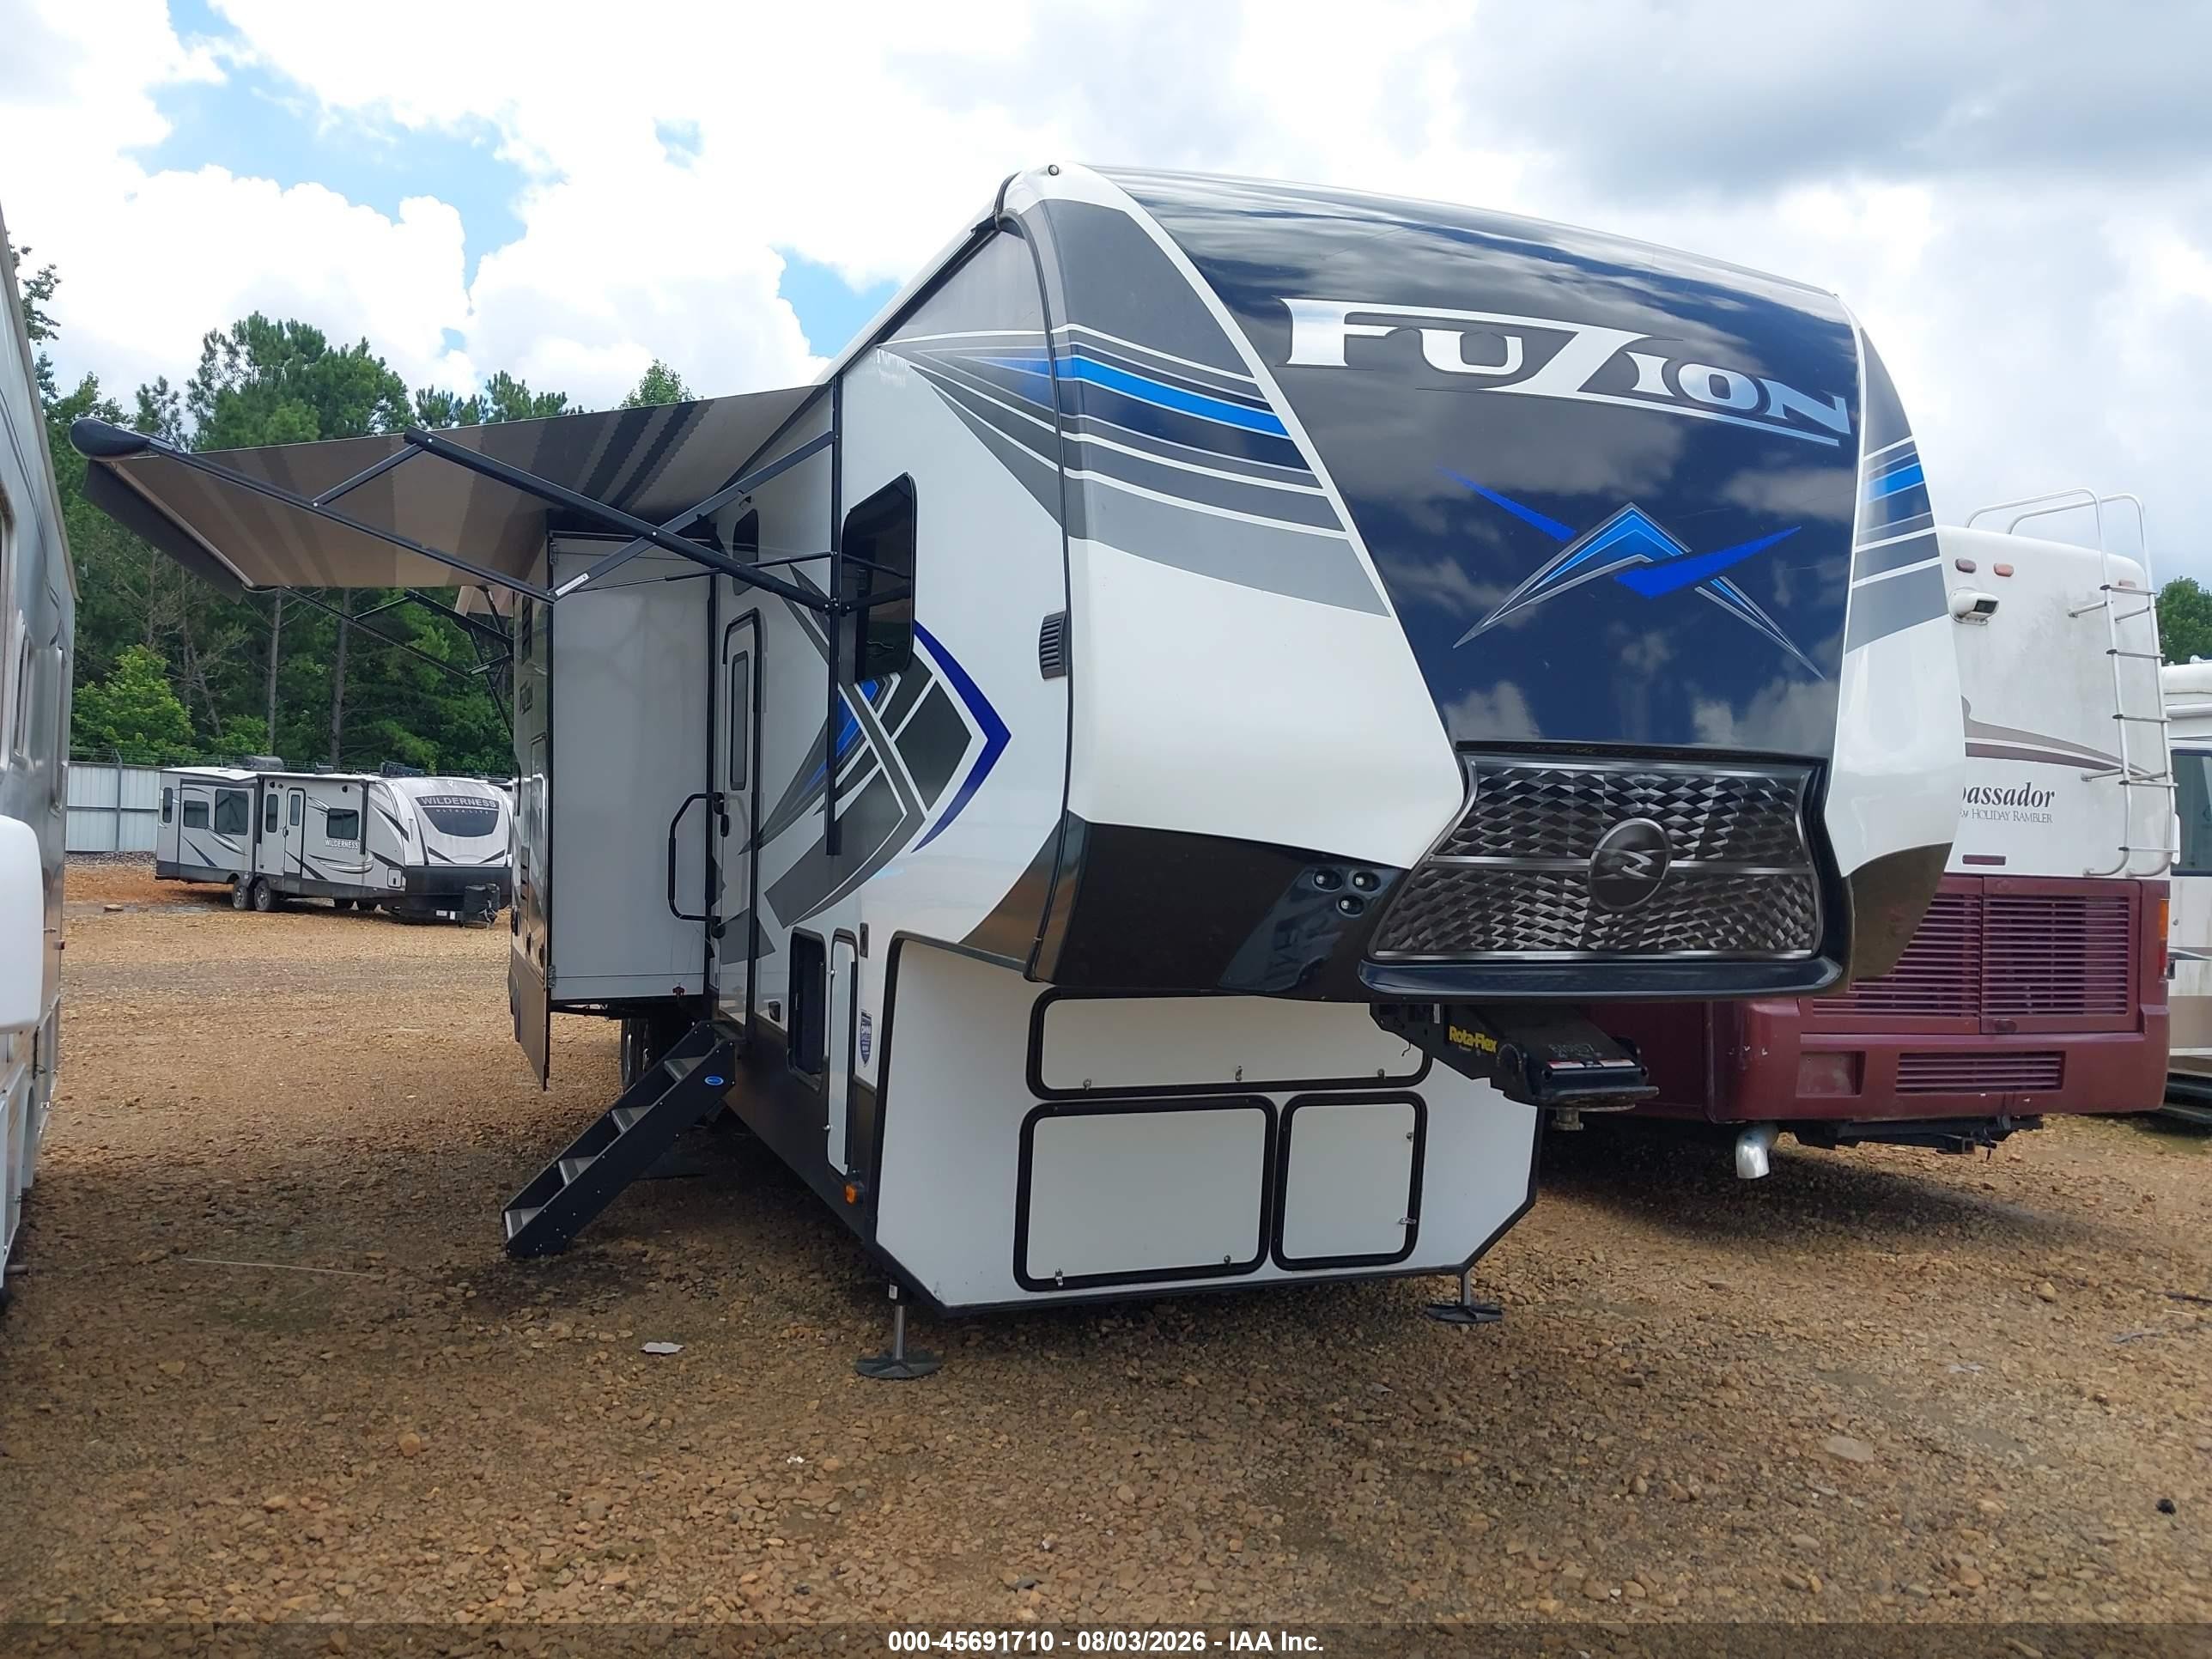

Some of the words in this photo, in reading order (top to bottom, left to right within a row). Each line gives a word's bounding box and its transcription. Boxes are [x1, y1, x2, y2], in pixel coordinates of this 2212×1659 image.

[1280, 297, 1851, 447] FUZION
[421, 796, 496, 808] WILDERNESS
[1972, 808, 2010, 821] HOLIDAY
[2013, 810, 2053, 823] RAMBLER
[325, 839, 359, 849] WILDERNESS
